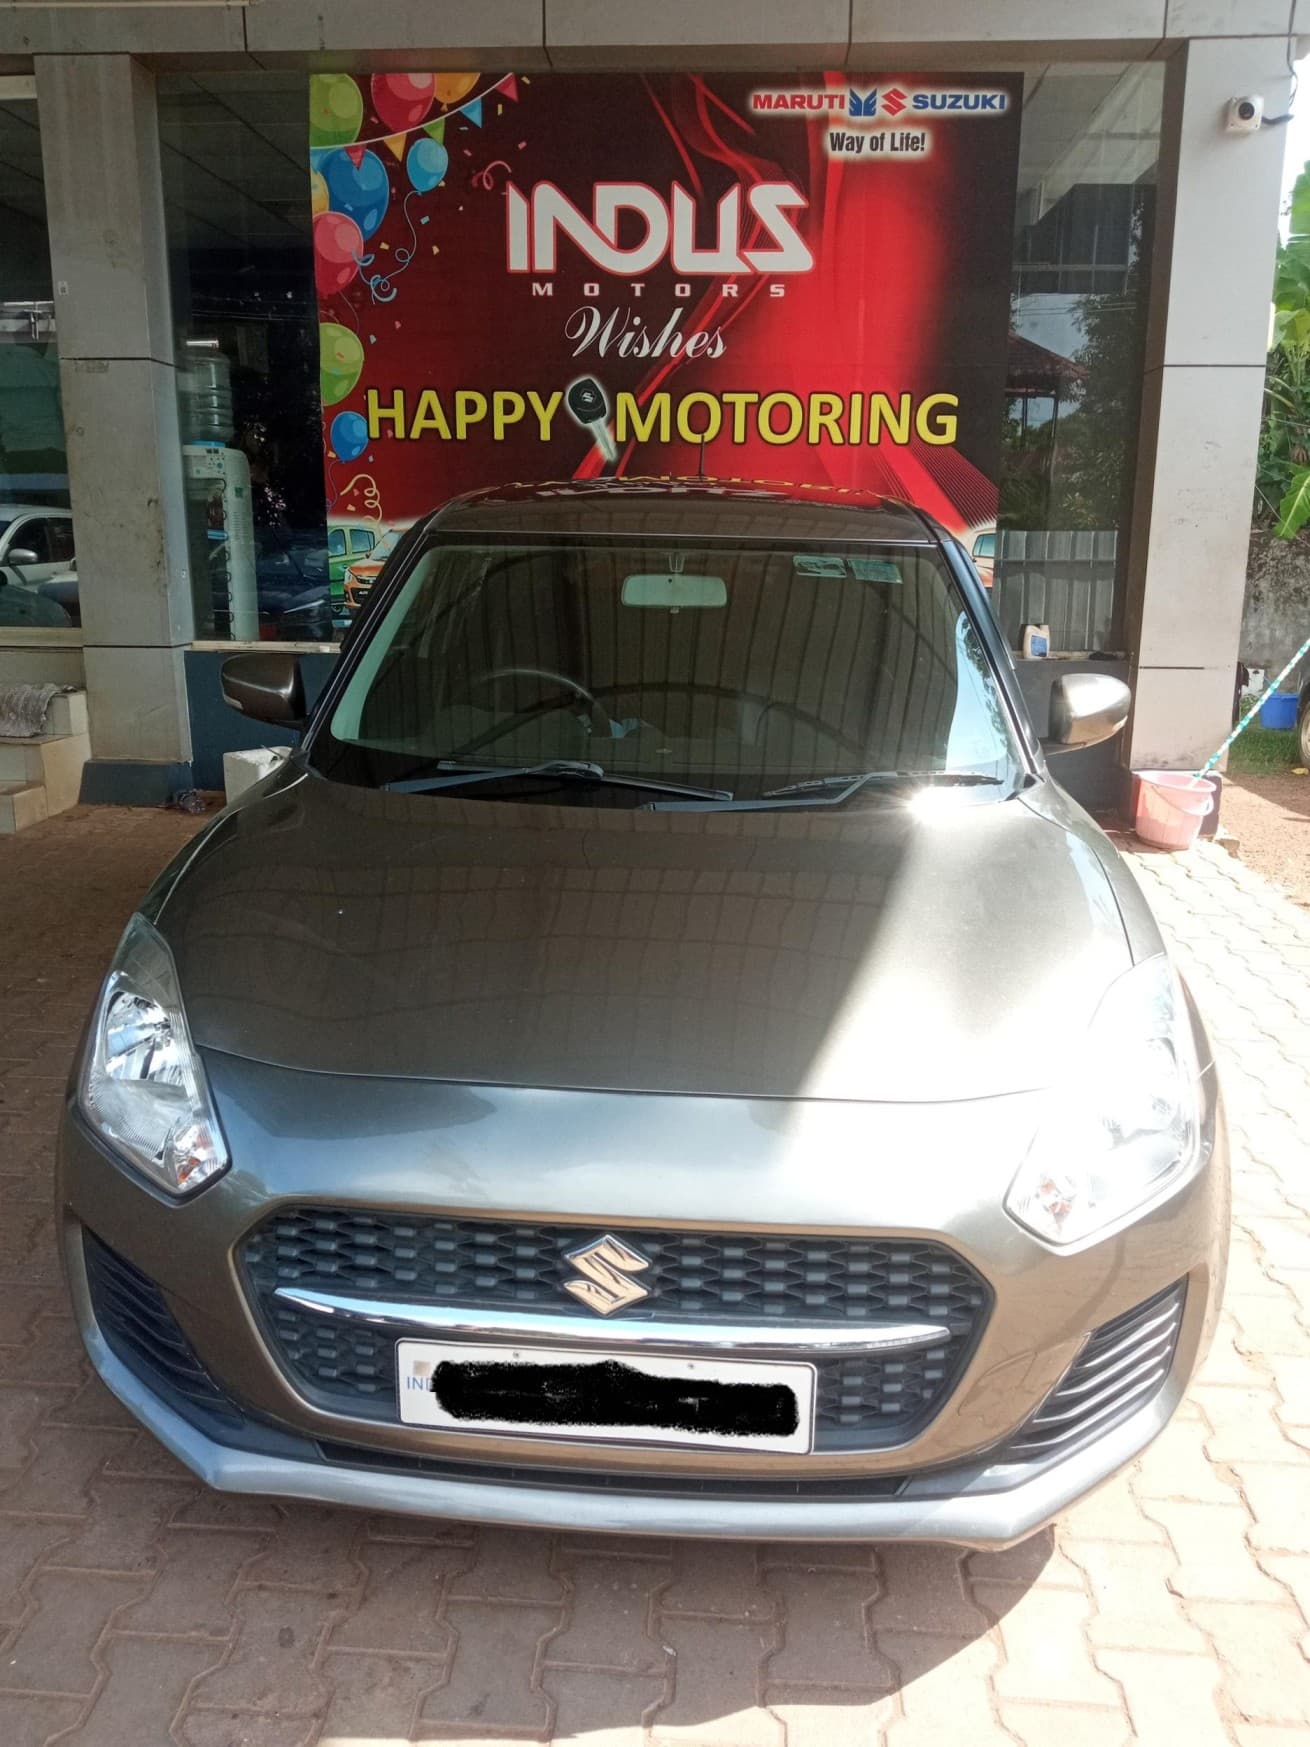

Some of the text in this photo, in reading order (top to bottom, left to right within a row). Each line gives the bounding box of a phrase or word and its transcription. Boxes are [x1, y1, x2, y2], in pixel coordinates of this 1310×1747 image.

[752, 93, 846, 110] MARUTI
[911, 93, 1006, 110] SUZUKI
[829, 131, 926, 153] Way of Life!
[506, 181, 816, 275] INDUS
[531, 282, 786, 297] MOTORS
[564, 305, 728, 359] Wishes
[366, 388, 960, 445] HAPPY MOTORING
